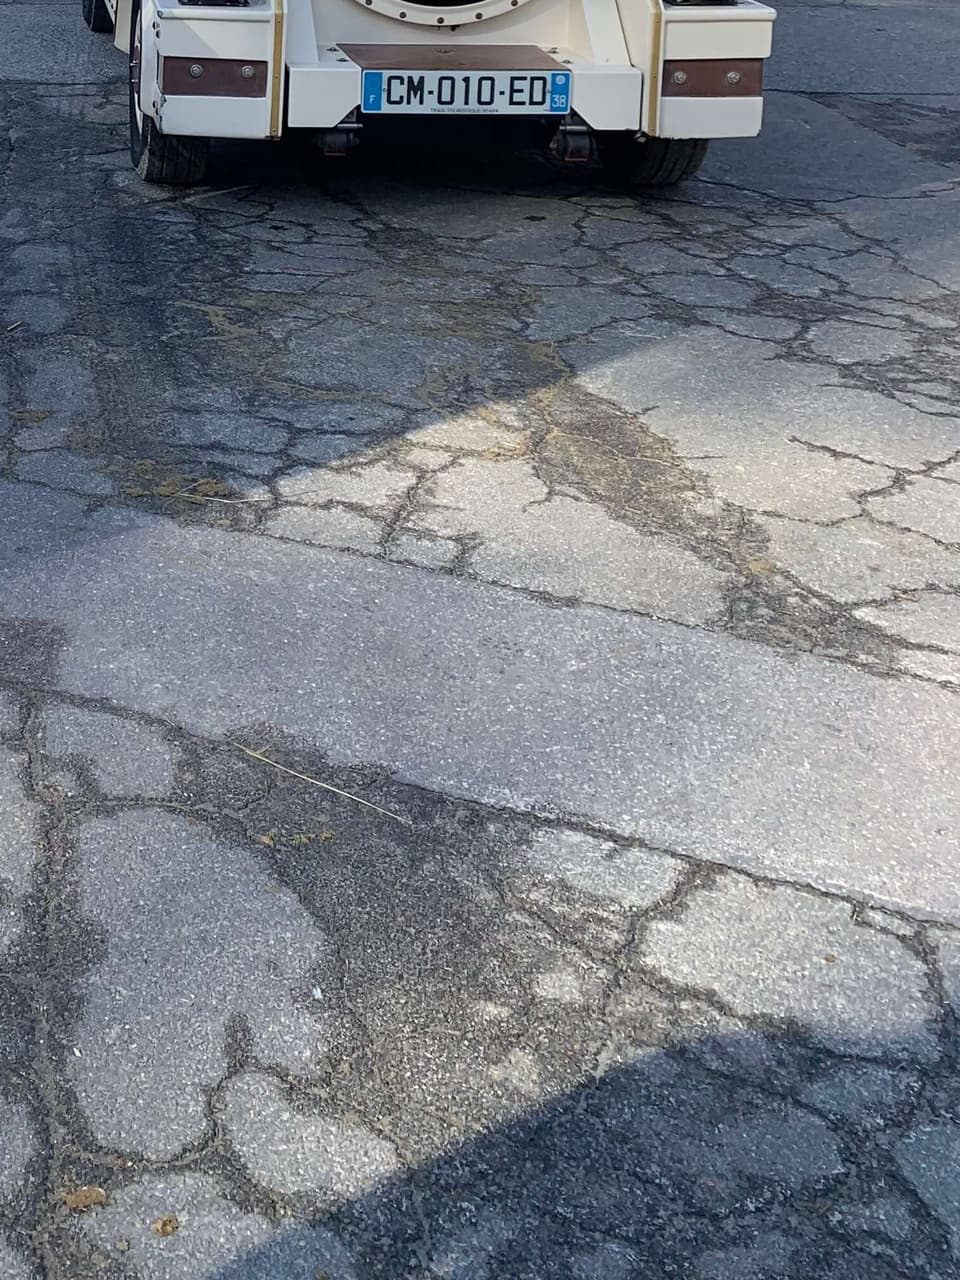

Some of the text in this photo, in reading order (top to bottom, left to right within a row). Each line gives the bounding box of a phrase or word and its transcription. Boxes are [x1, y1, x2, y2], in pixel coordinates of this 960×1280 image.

[386, 75, 548, 106] CM-010-ED
[368, 94, 376, 104] F
[552, 94, 567, 108] 38
